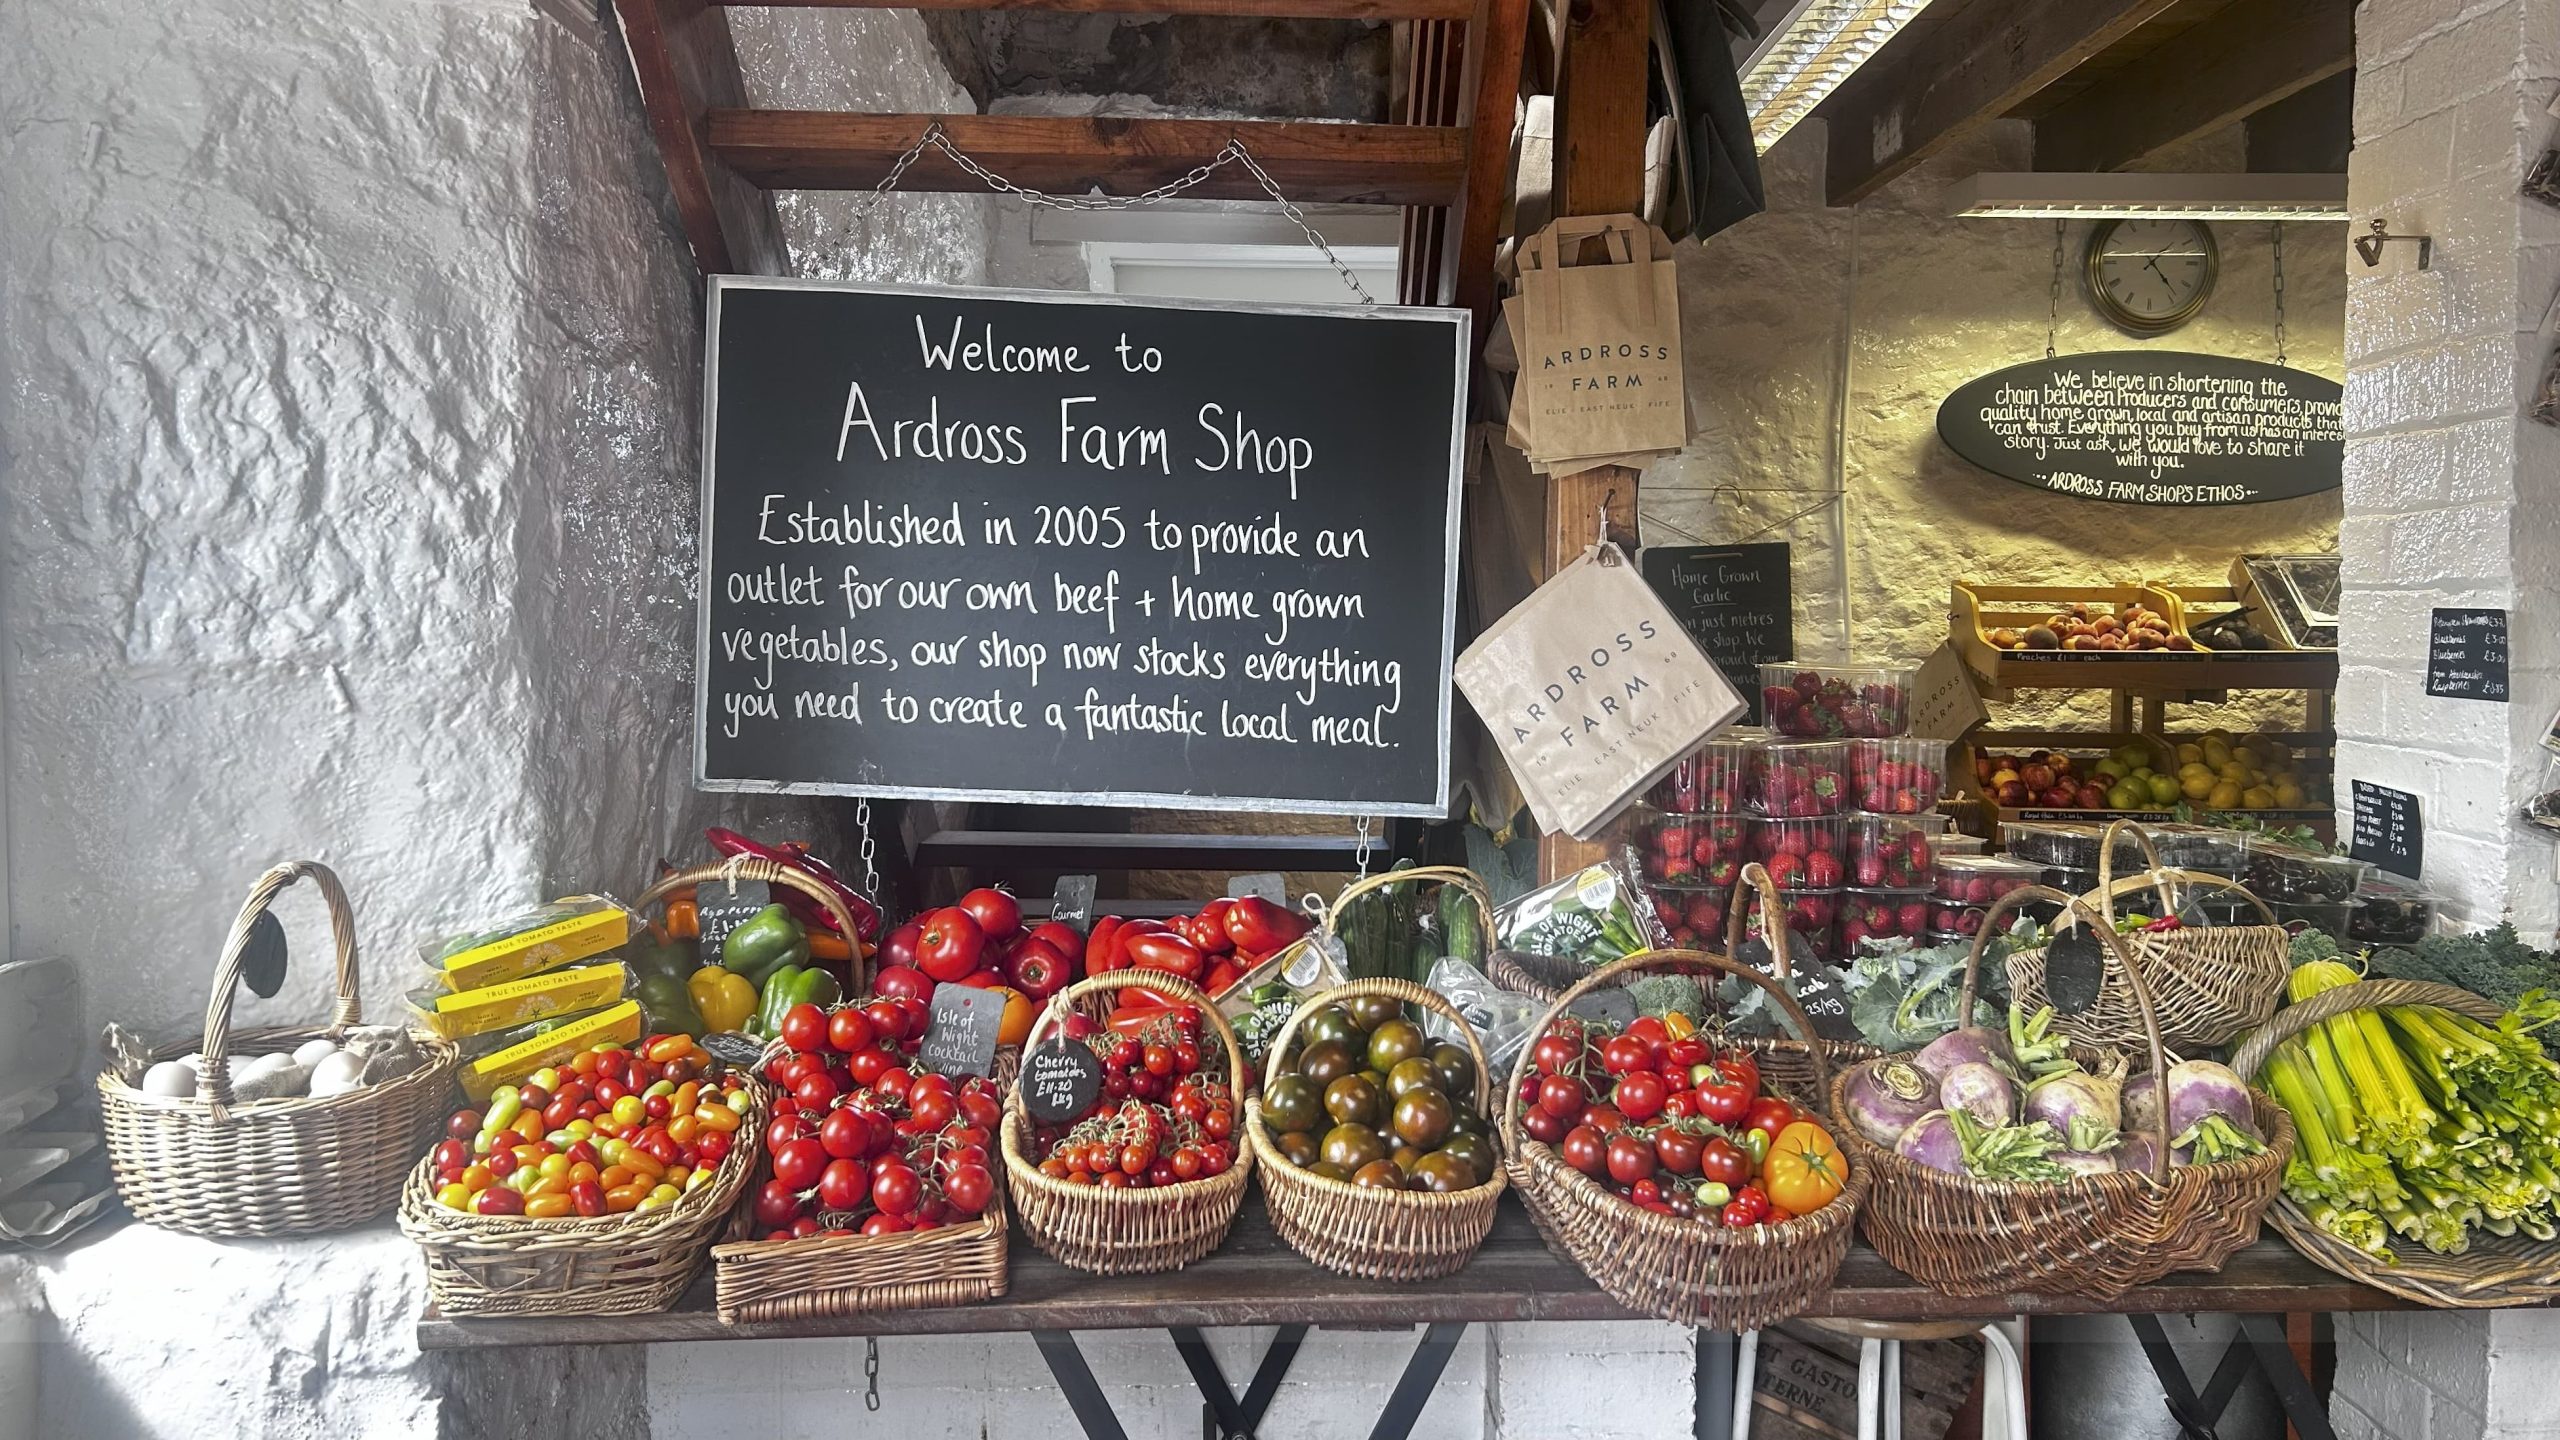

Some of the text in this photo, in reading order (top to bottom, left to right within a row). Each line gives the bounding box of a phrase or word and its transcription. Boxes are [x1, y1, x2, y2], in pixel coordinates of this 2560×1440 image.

[916, 314, 1162, 373] Welcome to
[1544, 344, 1669, 370] ARDROSS
[1572, 374, 1643, 391] FARM
[2053, 370, 2288, 396] We believe in shortening the
[1580, 404, 1604, 412] EAST
[1609, 403, 1636, 411] NEUK
[1995, 382, 2343, 423] chain between Producers and consumers, provid
[1980, 404, 2037, 430] quality
[2041, 404, 2085, 421] home
[2136, 408, 2168, 422] local
[2172, 408, 2198, 422] and
[2201, 410, 2251, 424] artisan
[2255, 412, 2313, 432] products
[2316, 416, 2344, 431] that
[1994, 421, 2022, 436] can
[2026, 419, 2065, 435] trust.
[2067, 419, 2142, 441] Everything
[2145, 424, 2174, 443] you
[2177, 423, 2202, 444] buy
[2203, 424, 2238, 438] from
[2240, 428, 2257, 438] us
[2259, 425, 2280, 438] has
[2282, 430, 2300, 440] an
[836, 381, 1313, 500] Ardross Farm Shop
[2004, 434, 2050, 460] story.
[2052, 436, 2082, 450] Just
[2086, 436, 2118, 453] ask,
[2147, 437, 2190, 455] would
[2194, 437, 2223, 456] love
[2226, 438, 2243, 455] to
[2247, 438, 2292, 457] share
[2294, 441, 2305, 456] it
[2115, 453, 2185, 480] with you.
[2107, 481, 2145, 502] FARM
[2145, 484, 2194, 503] SHOP'S
[758, 494, 1370, 576] Established in 2005 to provide an
[1671, 563, 1762, 590] Home Grown
[727, 562, 1365, 646] outlet for our own beef + home grown
[1693, 587, 1732, 604] Garlic
[1700, 610, 1726, 633] just
[1730, 612, 1774, 628] metres
[1745, 631, 1766, 646] We
[721, 624, 1402, 714] vegetables, our shop now stocks everything
[1513, 620, 1657, 744] ARDROSS
[724, 681, 1401, 749] you need to create a fantastic local meal.
[1560, 675, 1650, 747] FARM
[1914, 676, 1960, 727] ARDROSS
[1927, 701, 1954, 731] FARM
[1558, 679, 1701, 797] ELIE EAST NEUK FIFE
[492, 920, 582, 952] TRUE TOMATO TASTE
[1538, 918, 1556, 934] OF
[1555, 911, 1600, 940] WIGHT
[486, 973, 580, 999] TRUE TOMATO TASTE
[937, 1007, 975, 1033] Isle of
[1246, 1028, 1262, 1058] SLE
[1262, 1001, 1299, 1018] WIG
[505, 1047, 528, 1060] TRUE
[530, 1031, 567, 1050] TOMATO
[569, 1019, 596, 1033] TASTE
[941, 1026, 979, 1050] Wight
[1035, 1054, 1078, 1070] Cherry
[1035, 1067, 1087, 1082] tomatoes
[1036, 1079, 1073, 1097] £11.20
[1757, 1342, 1858, 1399] ST GASTO
[1760, 1371, 1826, 1413] TERNE
